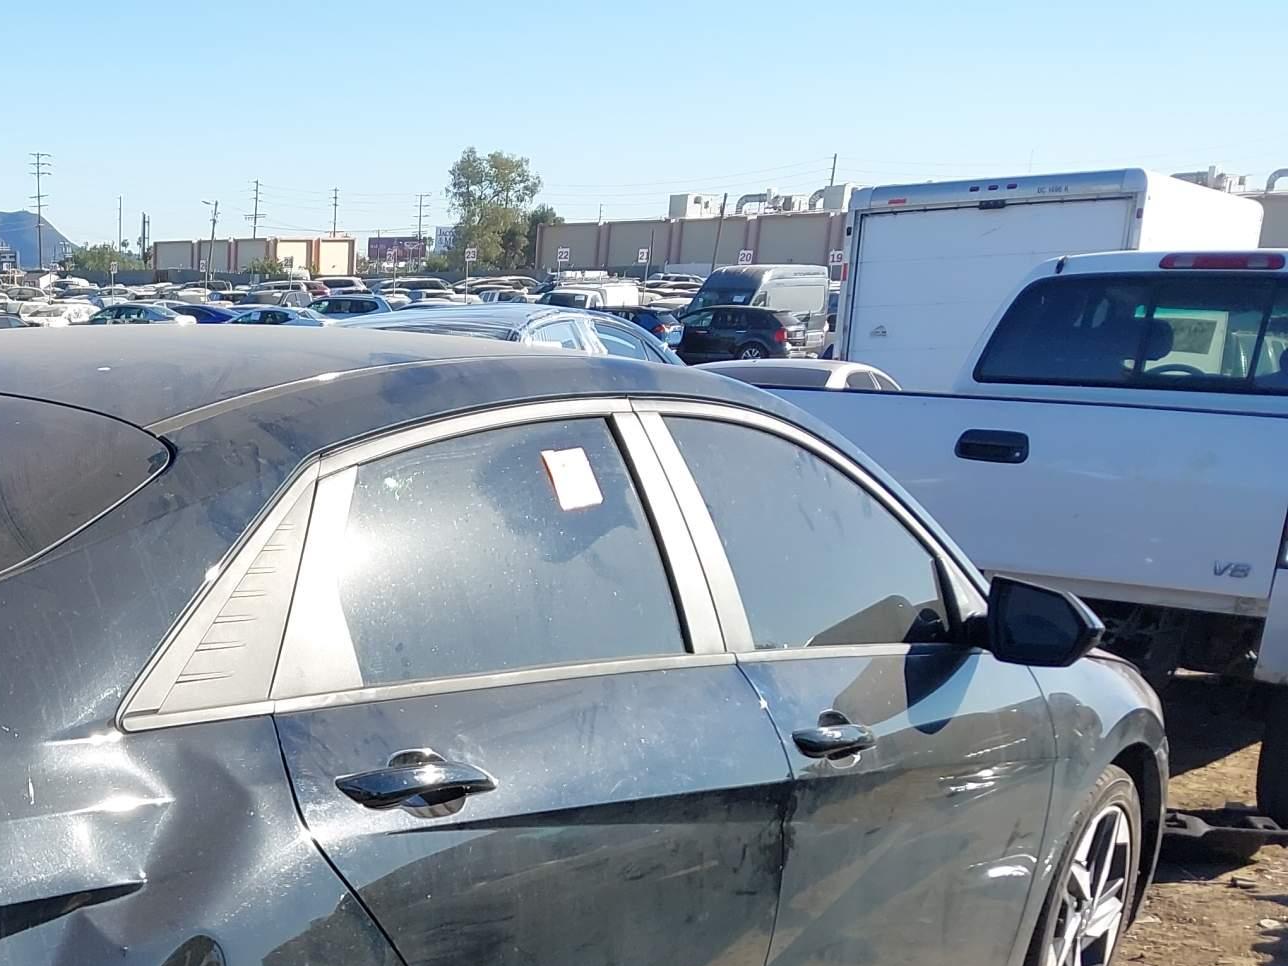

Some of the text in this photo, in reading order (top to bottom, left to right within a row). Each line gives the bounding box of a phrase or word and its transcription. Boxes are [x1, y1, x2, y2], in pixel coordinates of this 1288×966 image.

[466, 250, 476, 259] 23
[558, 250, 569, 260] 22
[739, 252, 752, 262] 20
[831, 253, 842, 262] 19
[1214, 560, 1251, 578] V8
